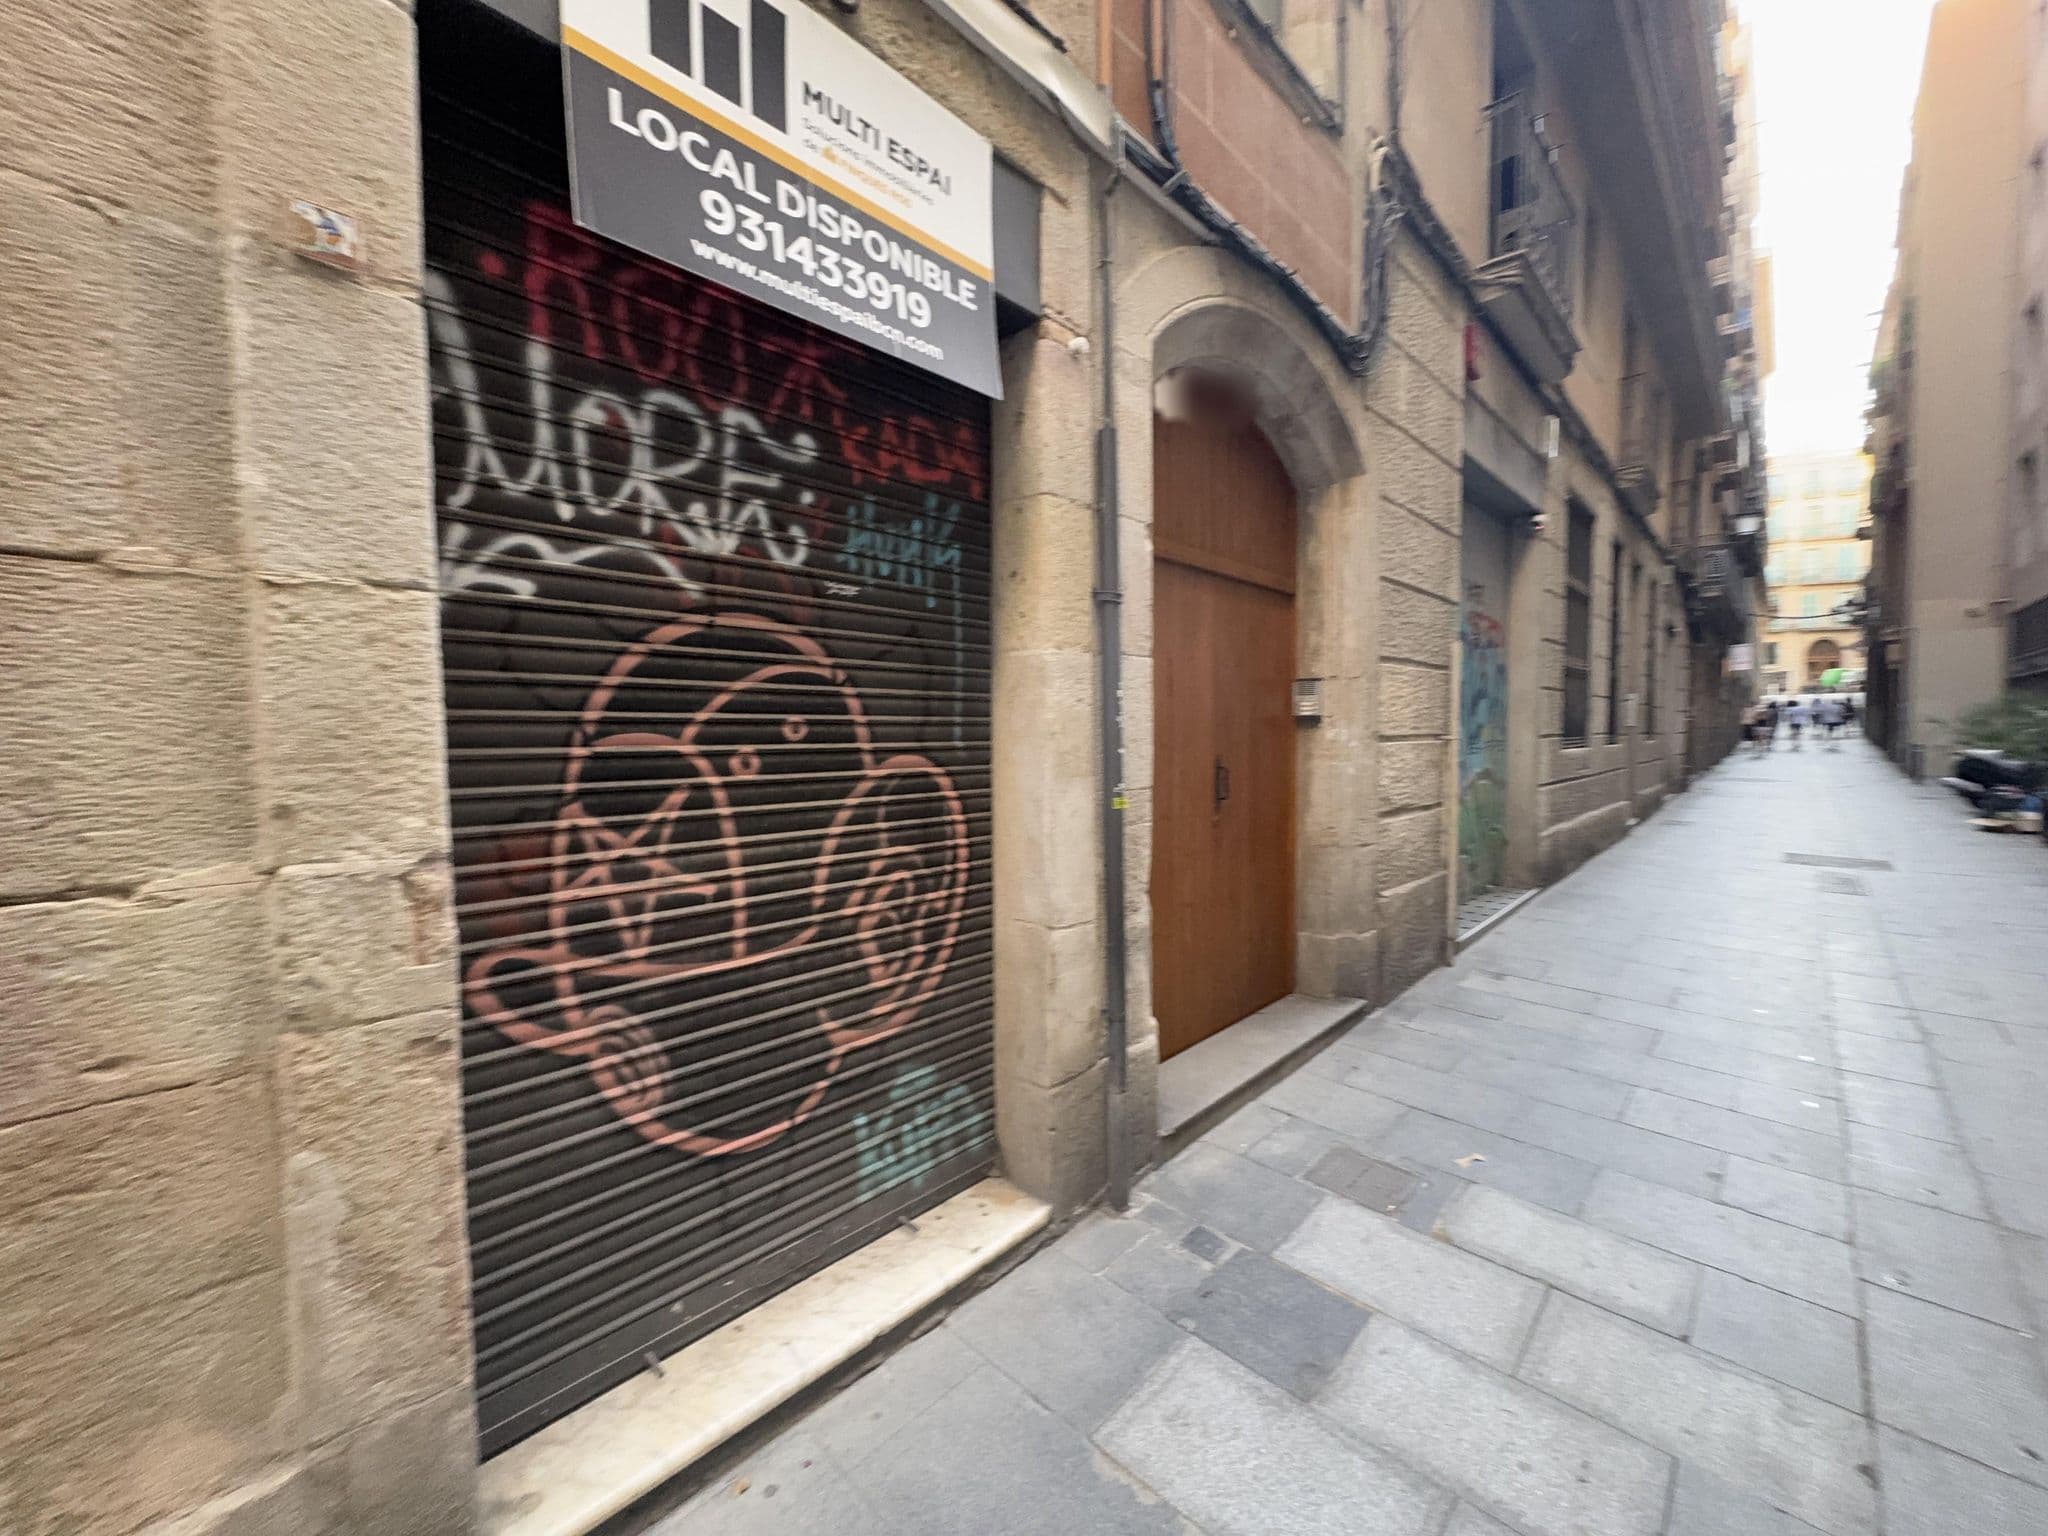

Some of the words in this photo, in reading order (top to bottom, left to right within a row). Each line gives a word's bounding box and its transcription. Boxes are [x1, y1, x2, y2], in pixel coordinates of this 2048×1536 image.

[607, 87, 771, 204] LOCAL
[775, 179, 978, 311] DISPONIBLE
[802, 79, 880, 151] MULTI
[887, 136, 952, 197] ESPAI
[700, 189, 932, 328] 931433919
